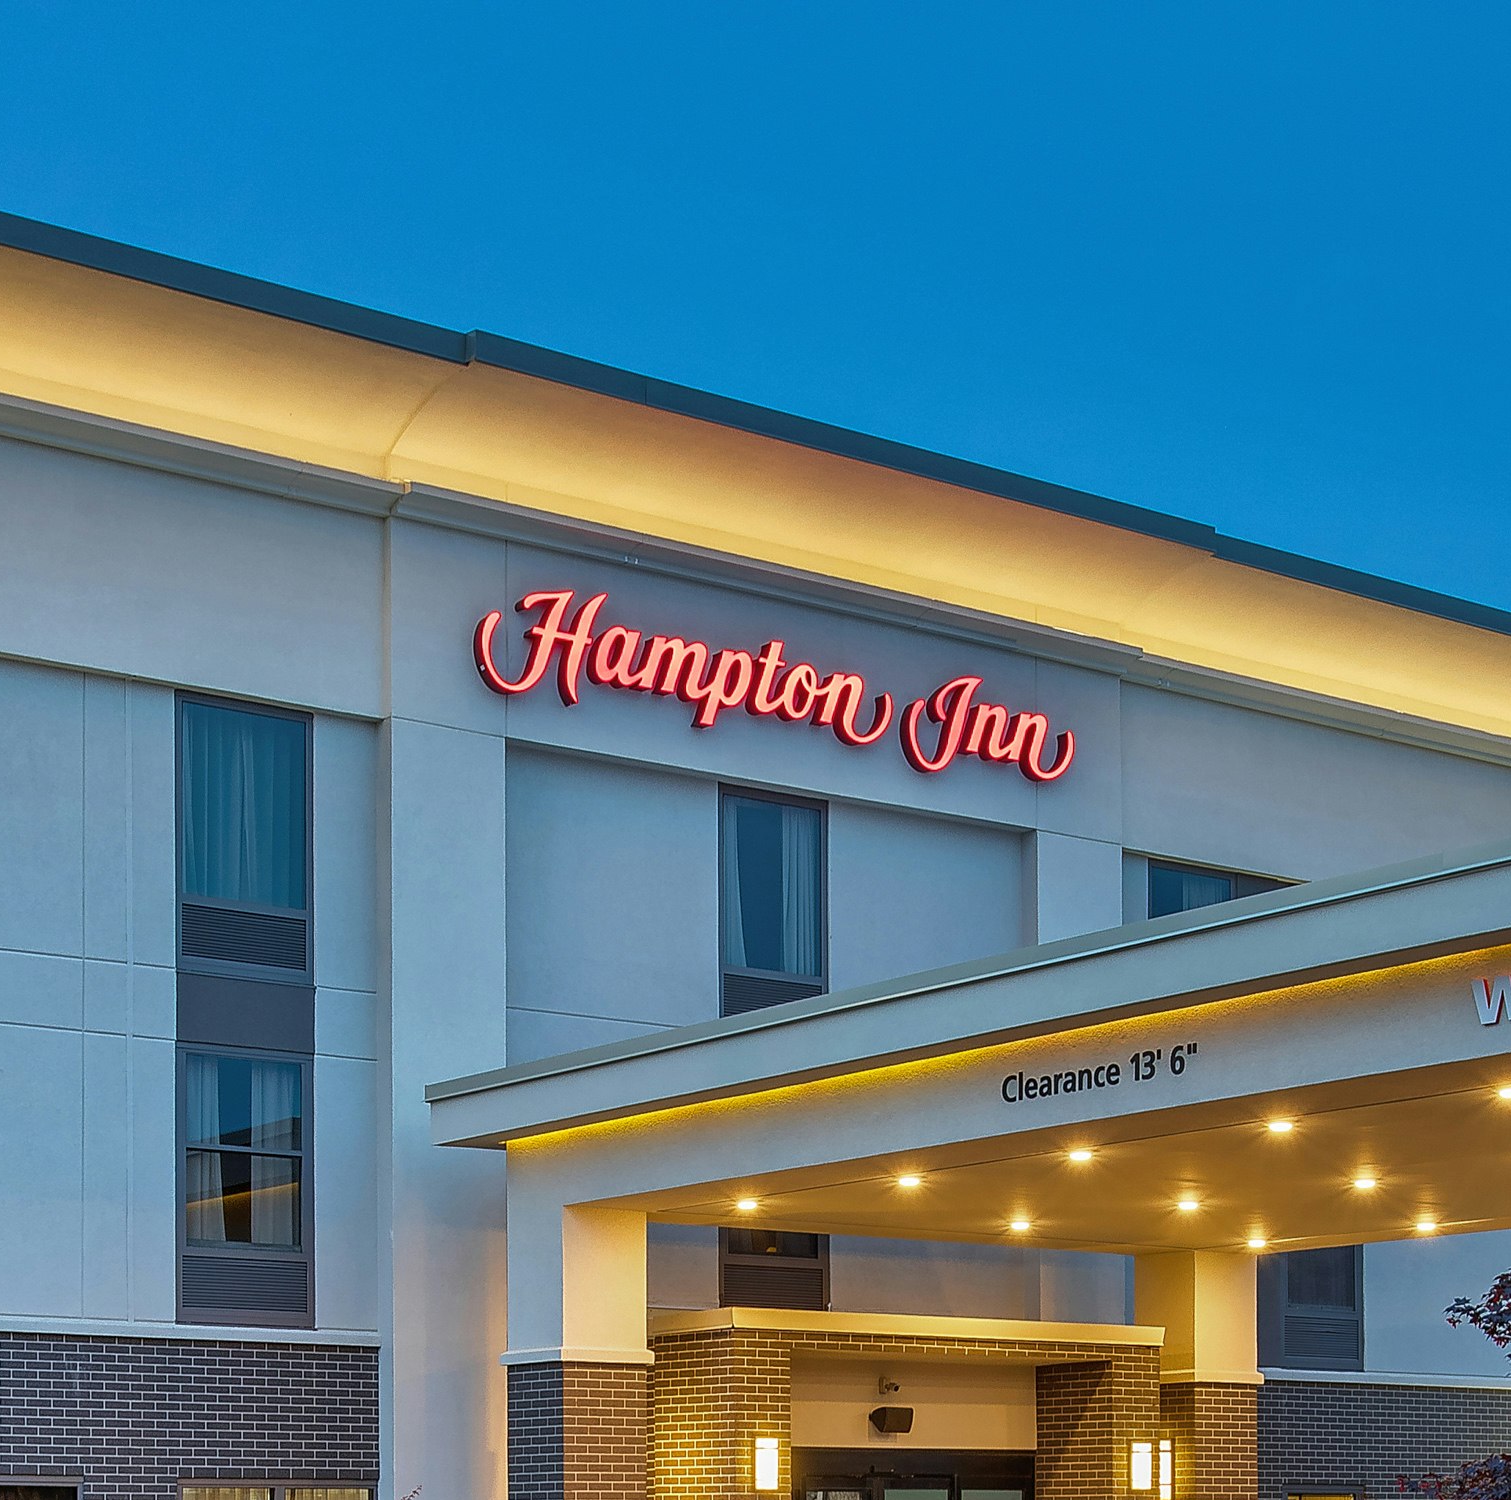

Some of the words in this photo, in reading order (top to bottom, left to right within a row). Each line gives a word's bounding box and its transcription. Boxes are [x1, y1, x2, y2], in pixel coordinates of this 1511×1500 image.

[473, 590, 892, 747] Hampton
[900, 676, 1076, 781] Inn
[1001, 1071, 1121, 1103] Clearance
[1129, 1049, 1162, 1081] 13'
[1169, 1042, 1199, 1075] 6"
